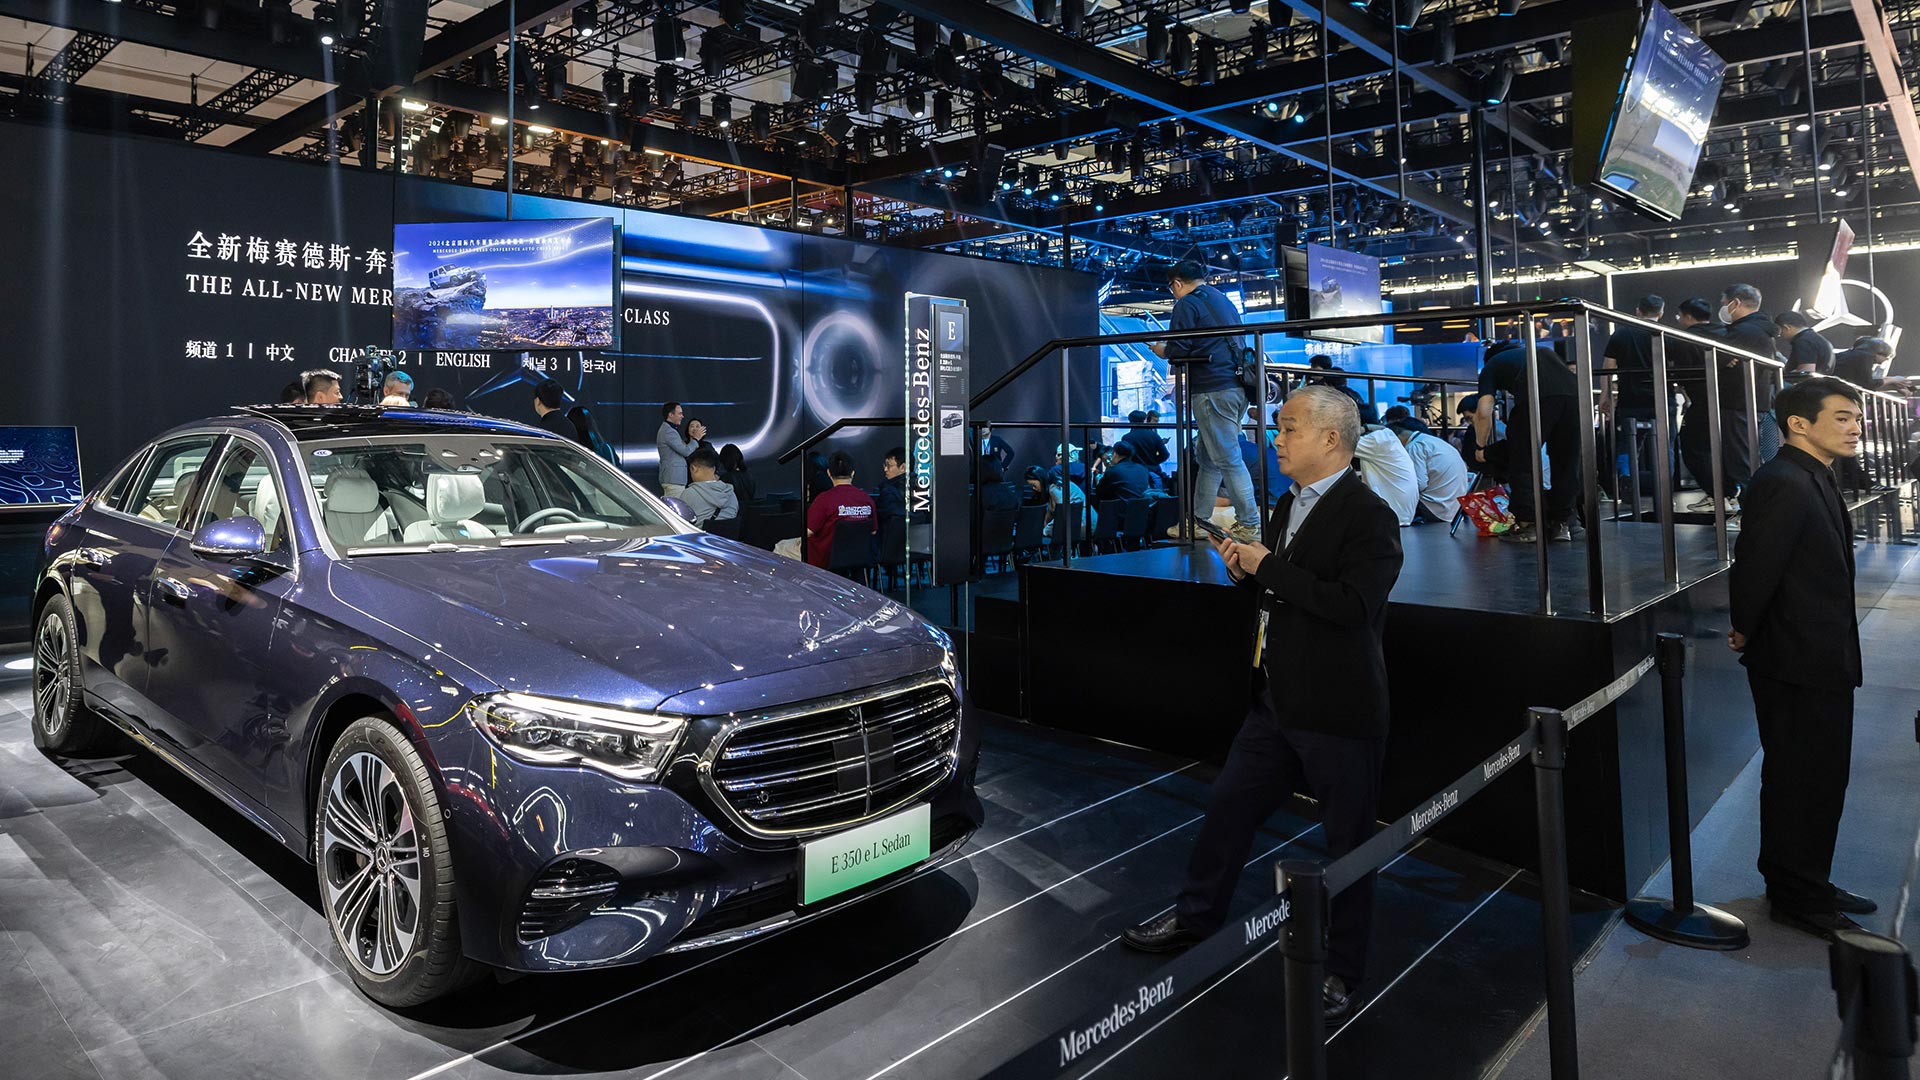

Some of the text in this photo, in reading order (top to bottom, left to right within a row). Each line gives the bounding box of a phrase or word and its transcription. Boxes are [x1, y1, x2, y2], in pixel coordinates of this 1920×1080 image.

[187, 230, 394, 275] 全新梅赛德斯-奔
[186, 274, 232, 295] THE
[242, 278, 343, 302] ALL-NEW
[948, 321, 956, 340] E
[185, 340, 217, 360] 频道
[226, 343, 234, 358] 1
[266, 343, 295, 362] 中文
[398, 350, 407, 365] 2
[436, 352, 491, 369] ENGLISH
[522, 356, 546, 371] 채널
[550, 357, 557, 371] 3
[582, 359, 616, 374] 한국어
[913, 328, 930, 512] Mercedes-Benz
[1483, 744, 1520, 781] Mercedes-Benz
[1411, 789, 1459, 835] Mercedes-Benz
[831, 833, 911, 874] E 350 e L Sedan
[1058, 975, 1174, 1067] Mercedes-Benz
